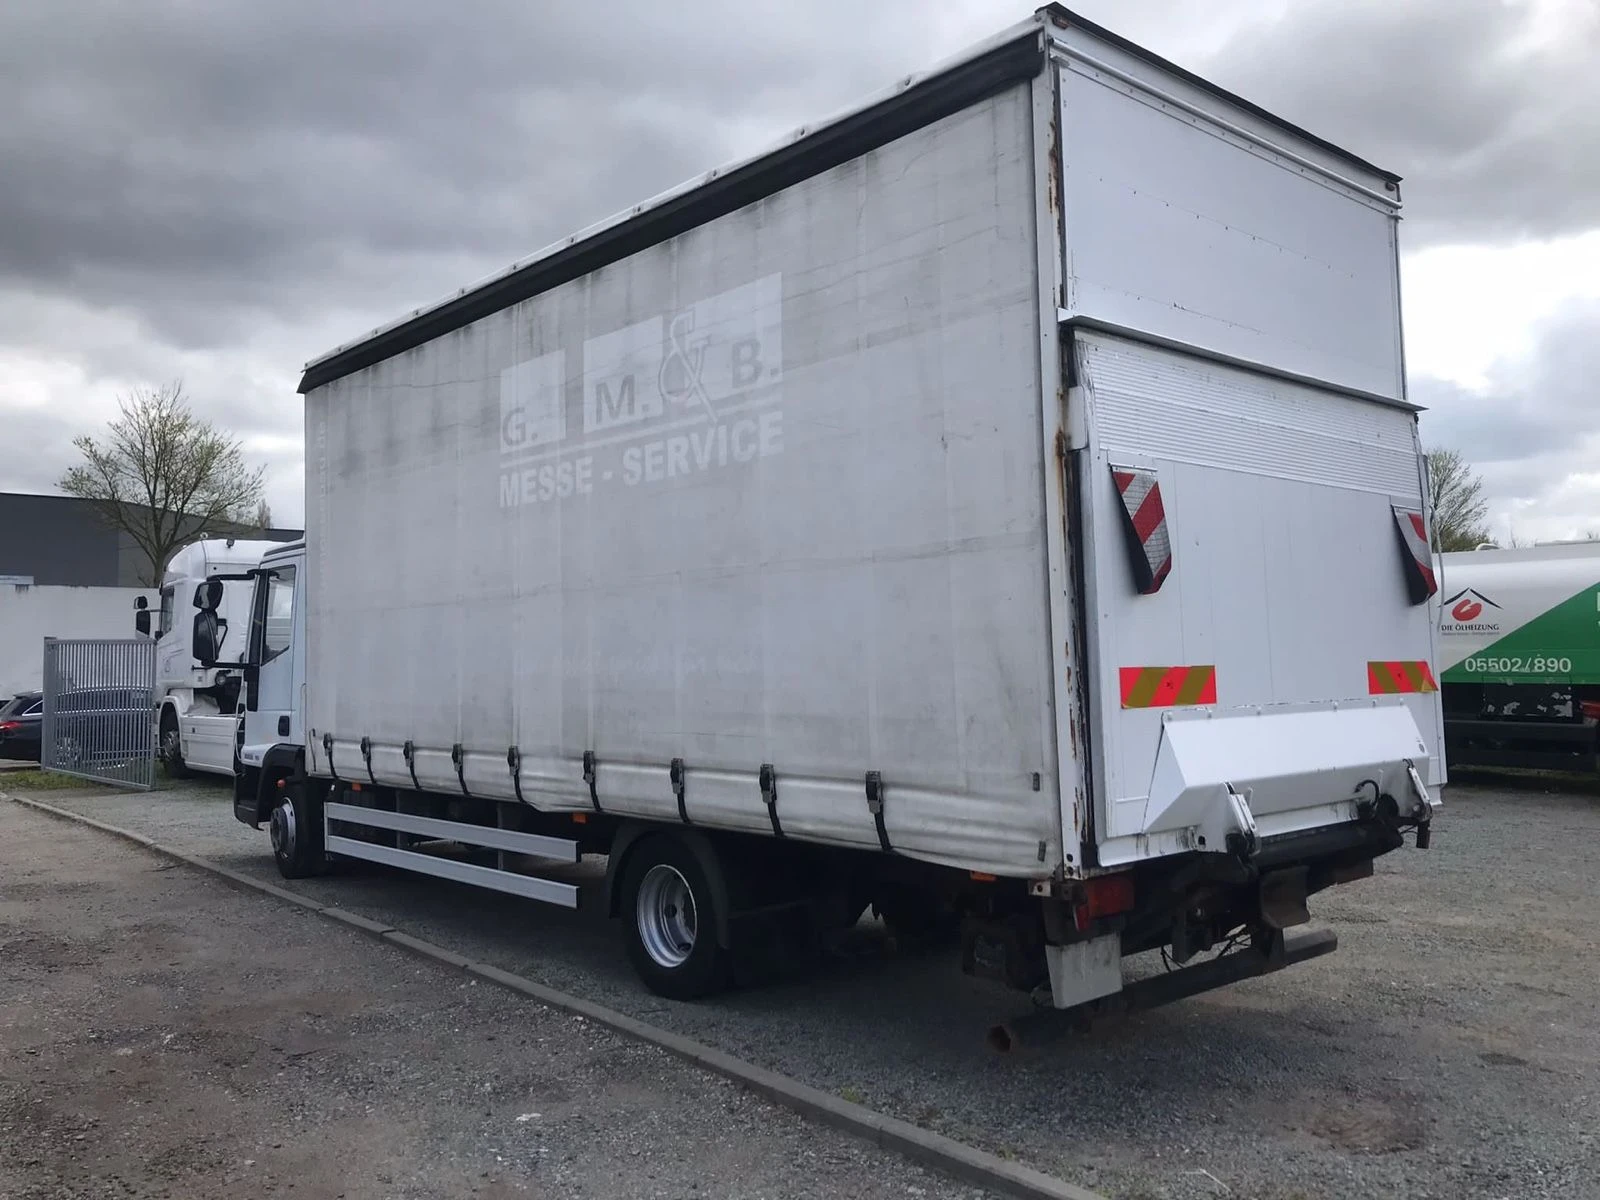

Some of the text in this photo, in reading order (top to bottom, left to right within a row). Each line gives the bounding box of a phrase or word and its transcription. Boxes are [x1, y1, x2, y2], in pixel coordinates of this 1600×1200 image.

[594, 374, 650, 425] M.
[731, 338, 782, 388] B.
[499, 455, 593, 509] MESSE
[622, 410, 784, 486] SERVICE
[1441, 622, 1500, 632] DIE ÖLHEIZUNG
[1465, 657, 1572, 673] 05502/890
